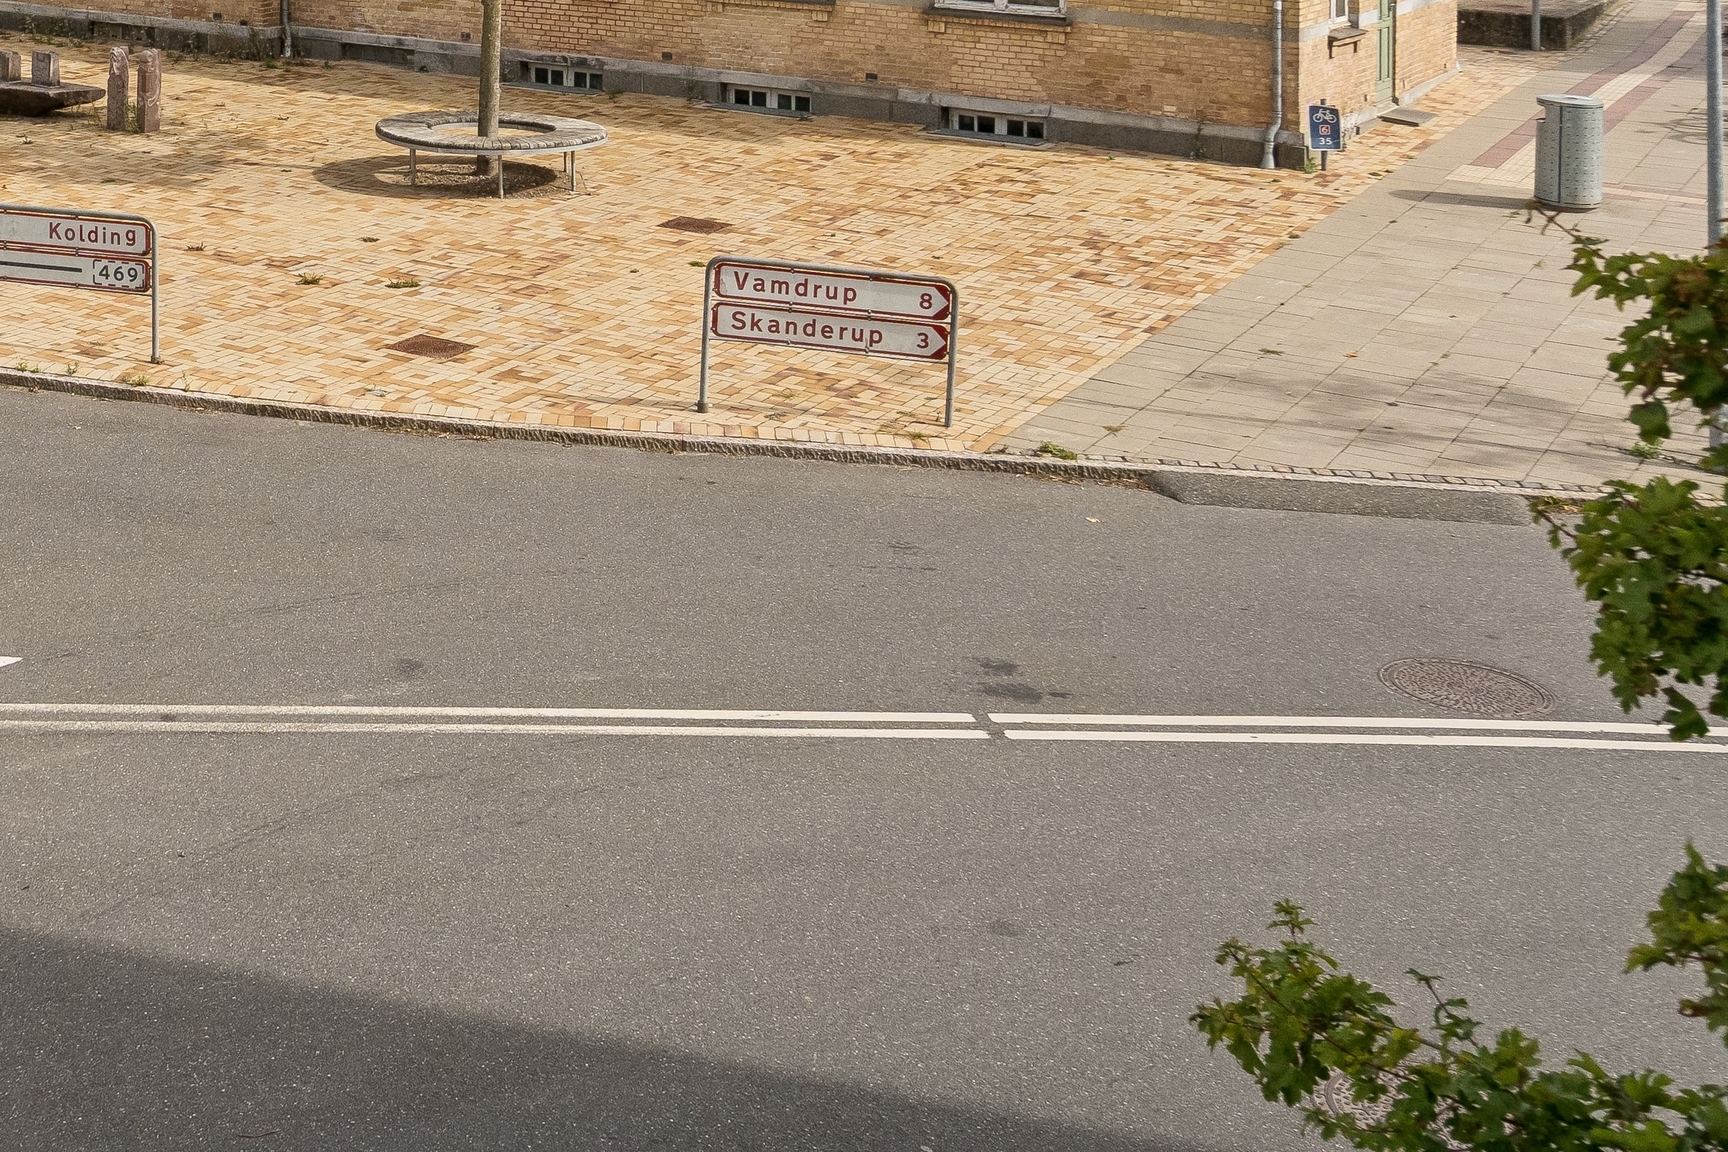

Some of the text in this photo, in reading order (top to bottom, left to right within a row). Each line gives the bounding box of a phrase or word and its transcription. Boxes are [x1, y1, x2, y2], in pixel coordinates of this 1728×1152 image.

[1319, 137, 1332, 145] 35
[49, 222, 137, 246] Kolding
[98, 264, 139, 283] 469
[733, 271, 933, 310] Vamdrup 8
[731, 310, 930, 349] Skanderup 3
